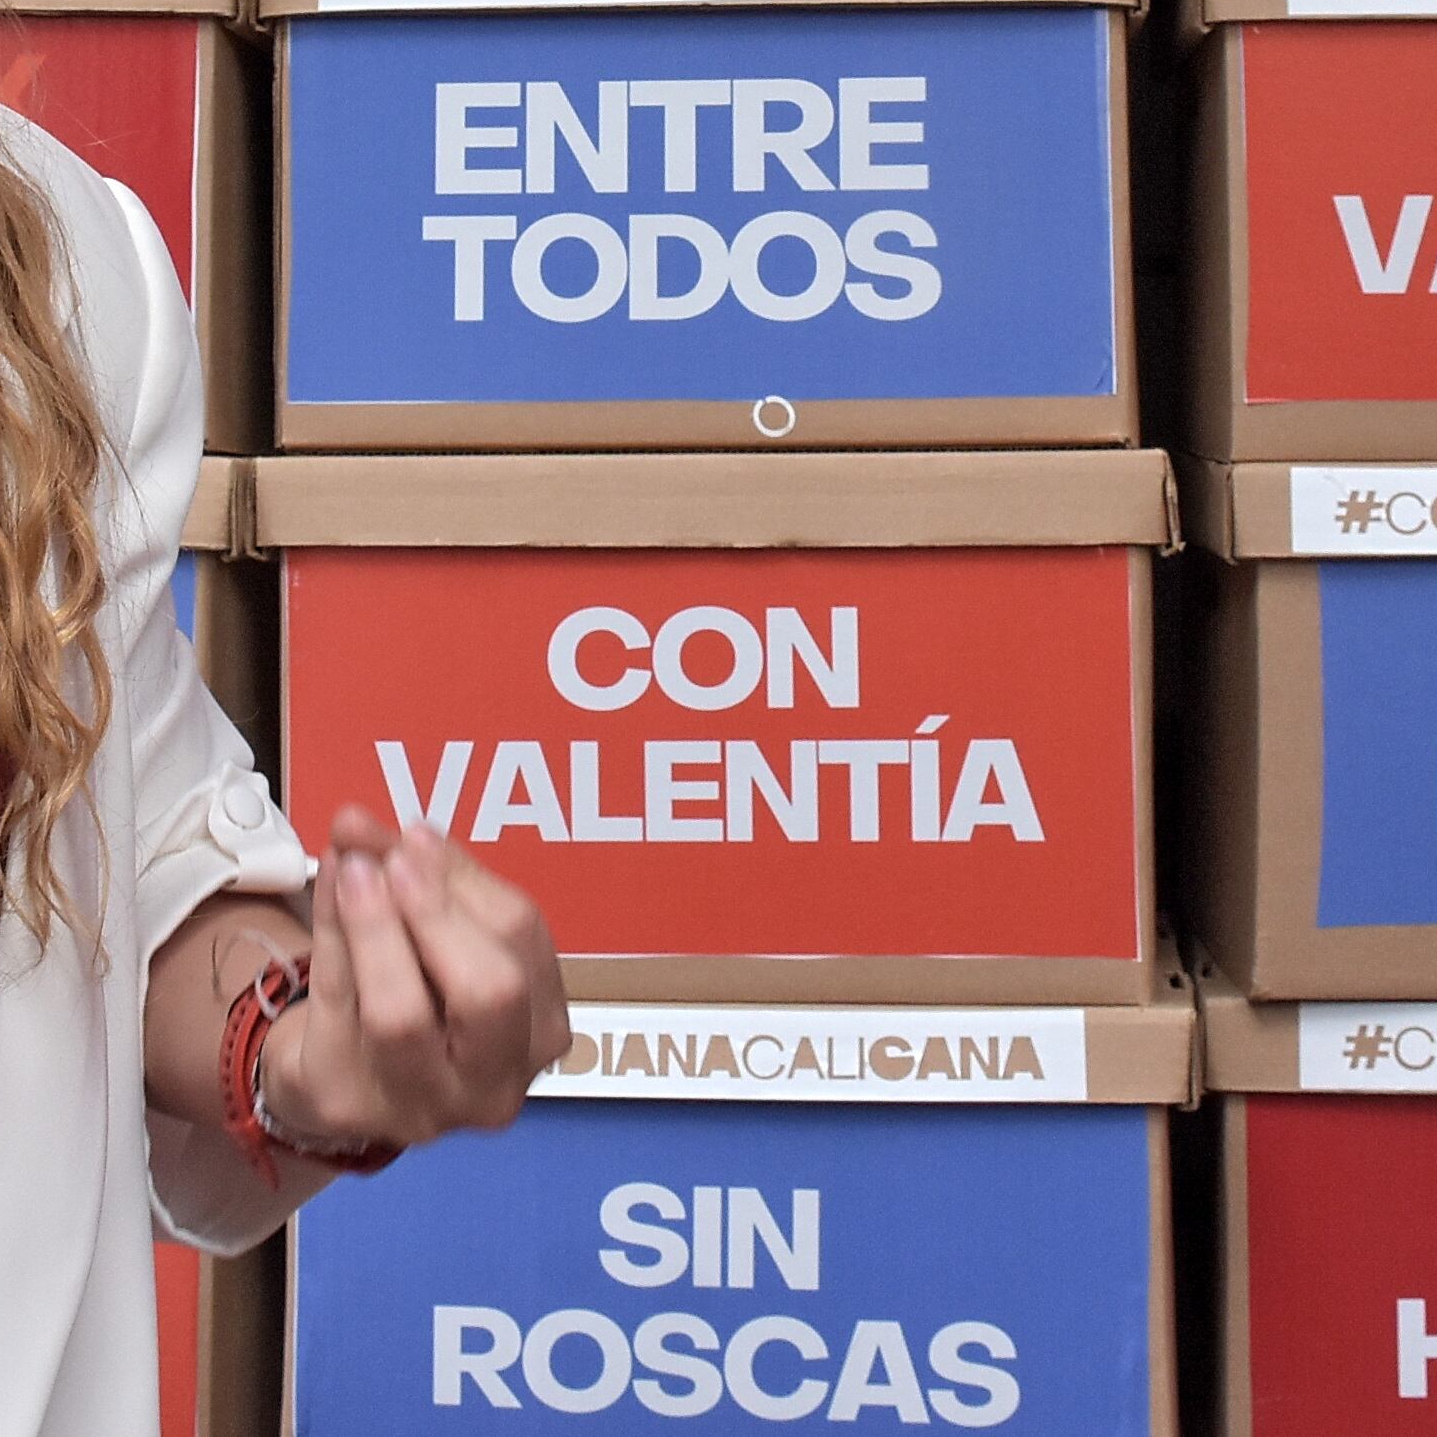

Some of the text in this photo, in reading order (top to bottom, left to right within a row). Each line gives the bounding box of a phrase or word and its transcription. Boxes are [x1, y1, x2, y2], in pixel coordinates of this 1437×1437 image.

[436, 77, 928, 194] ENTRE
[423, 211, 941, 322] TODOS
[548, 607, 859, 710] CON
[376, 716, 1044, 841] VALENTÍA
[601, 1184, 819, 1290] SIN
[434, 1307, 1019, 1426] ROSCAS
